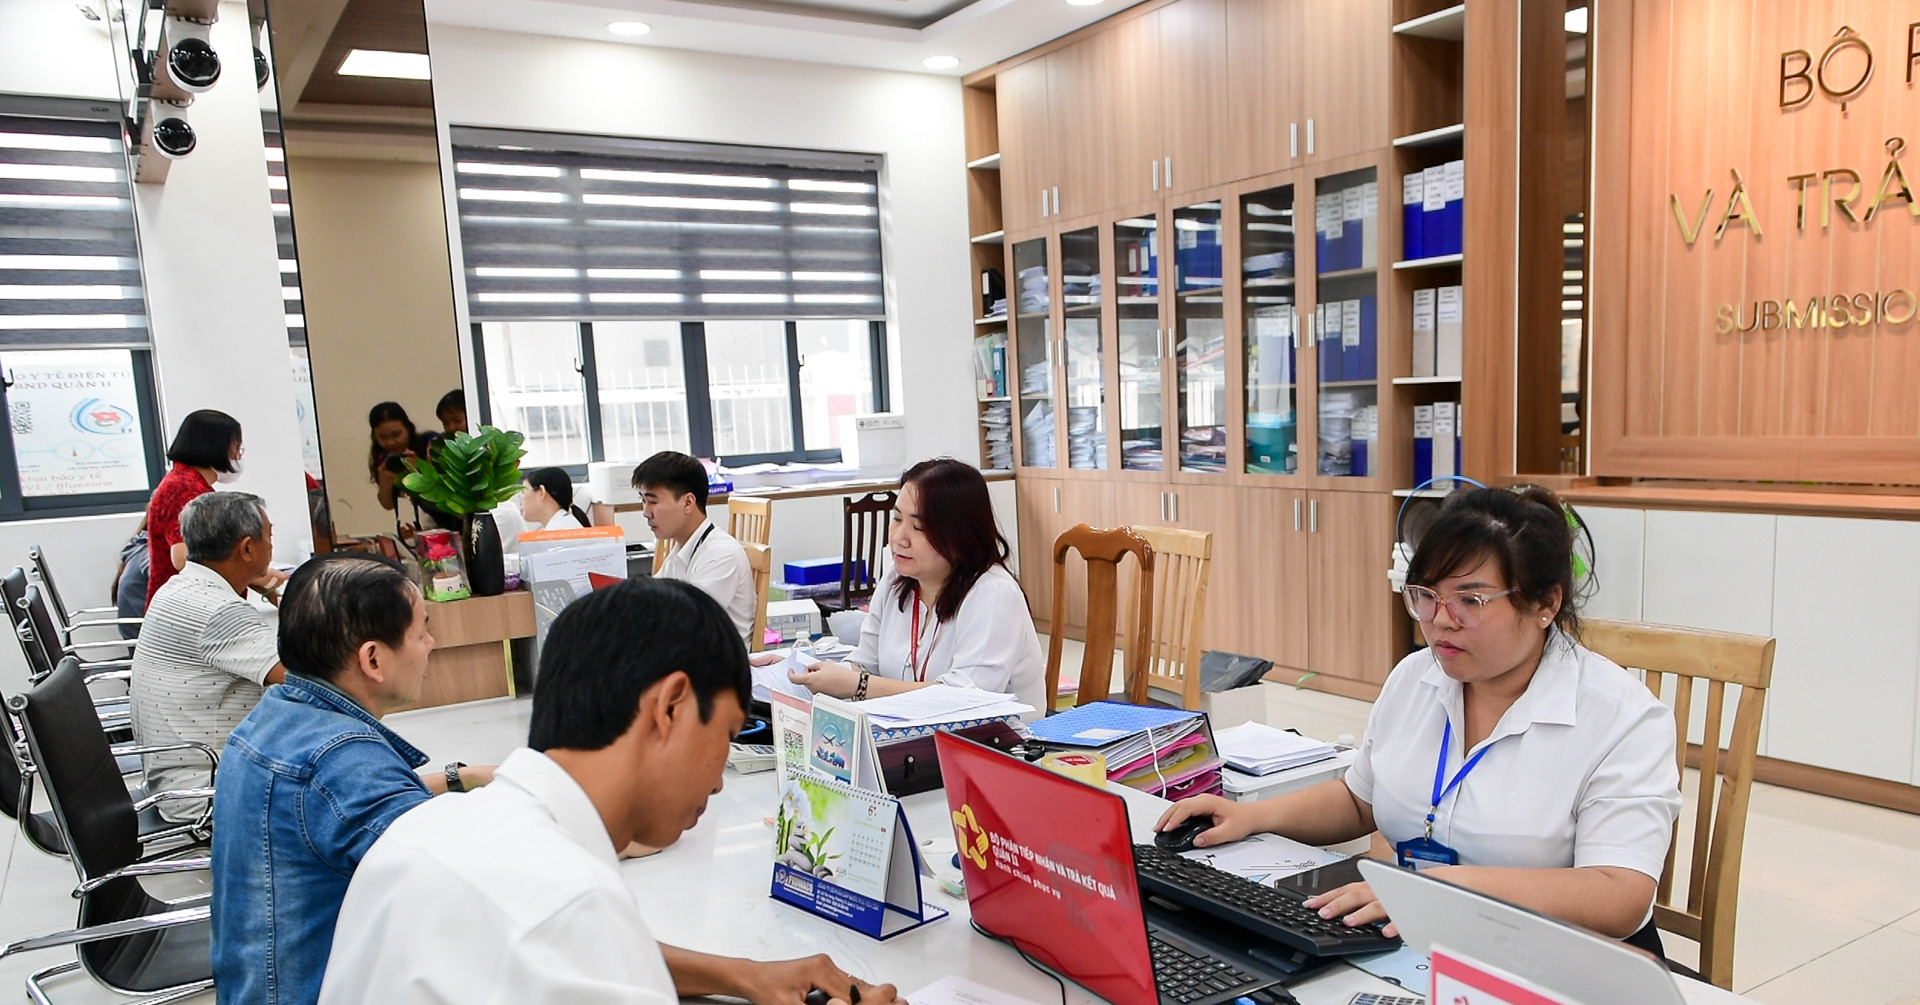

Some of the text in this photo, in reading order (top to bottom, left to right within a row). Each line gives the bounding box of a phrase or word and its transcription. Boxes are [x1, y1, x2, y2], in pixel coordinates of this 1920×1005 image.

[1779, 25, 1873, 113] BỘ
[1670, 137, 1920, 244] VÀ TRẢ
[1715, 289, 1920, 335] SUBMISSIO
[989, 831, 1000, 845] BỘ
[1019, 845, 1035, 861] TIẾP
[1034, 853, 1056, 873] NHẬN
[1066, 867, 1082, 885] TRẢ
[1081, 874, 1097, 892] KẾT
[1097, 882, 1116, 900] QUẢ
[992, 845, 1012, 864] QUẬN
